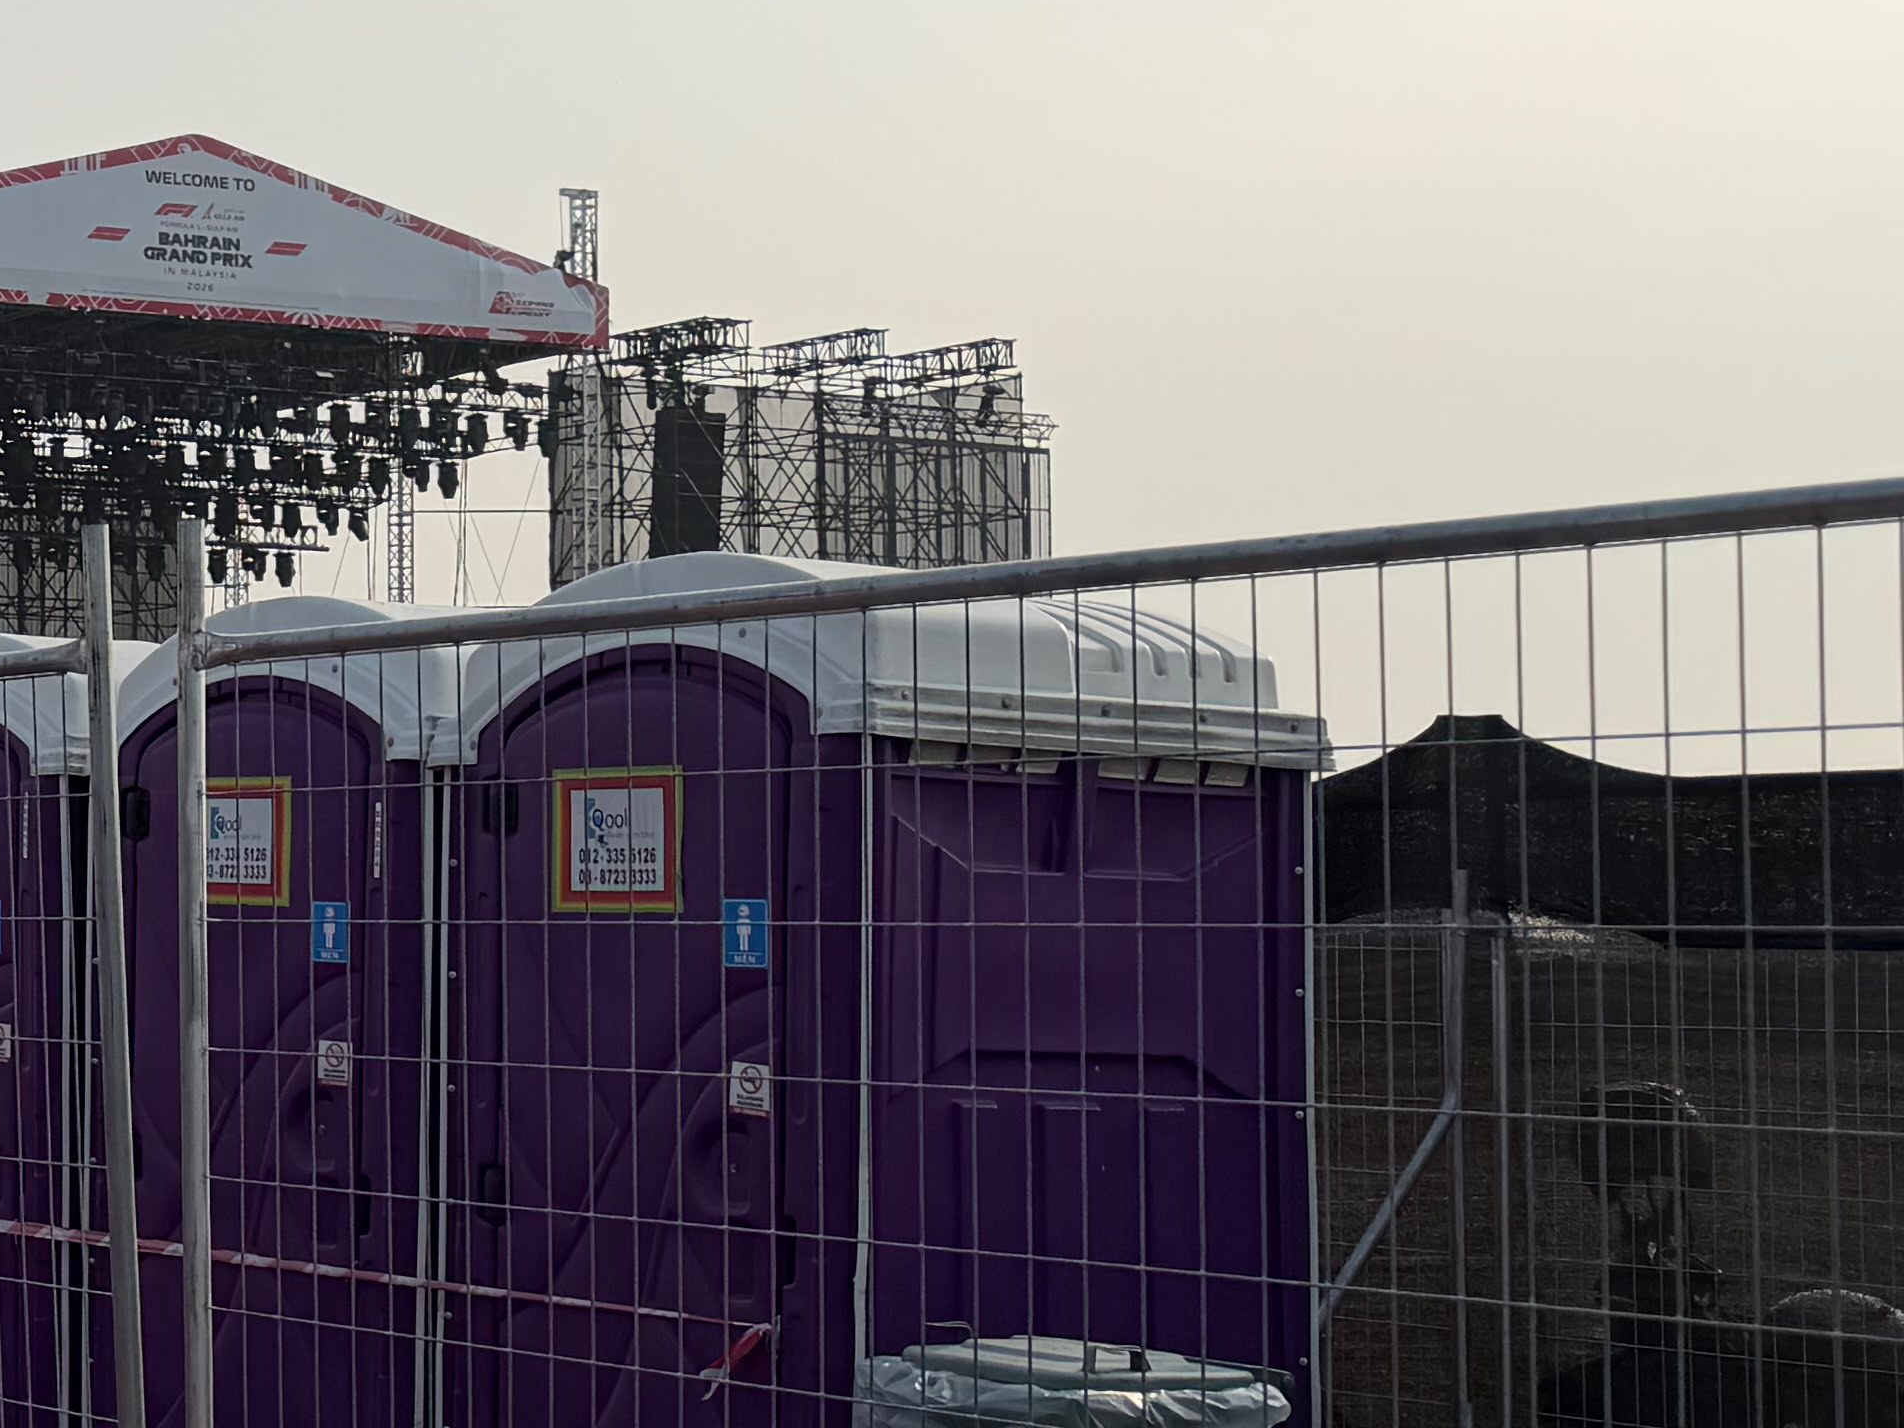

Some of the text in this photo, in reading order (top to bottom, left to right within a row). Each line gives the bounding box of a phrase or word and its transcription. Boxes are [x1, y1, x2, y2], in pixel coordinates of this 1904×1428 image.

[145, 170, 255, 192] WELCOME TO
[158, 231, 240, 251] BAHRAIN
[144, 246, 253, 269] GRAND PRIX
[164, 266, 237, 279] IN MALAYSIA
[186, 282, 214, 292] 2026
